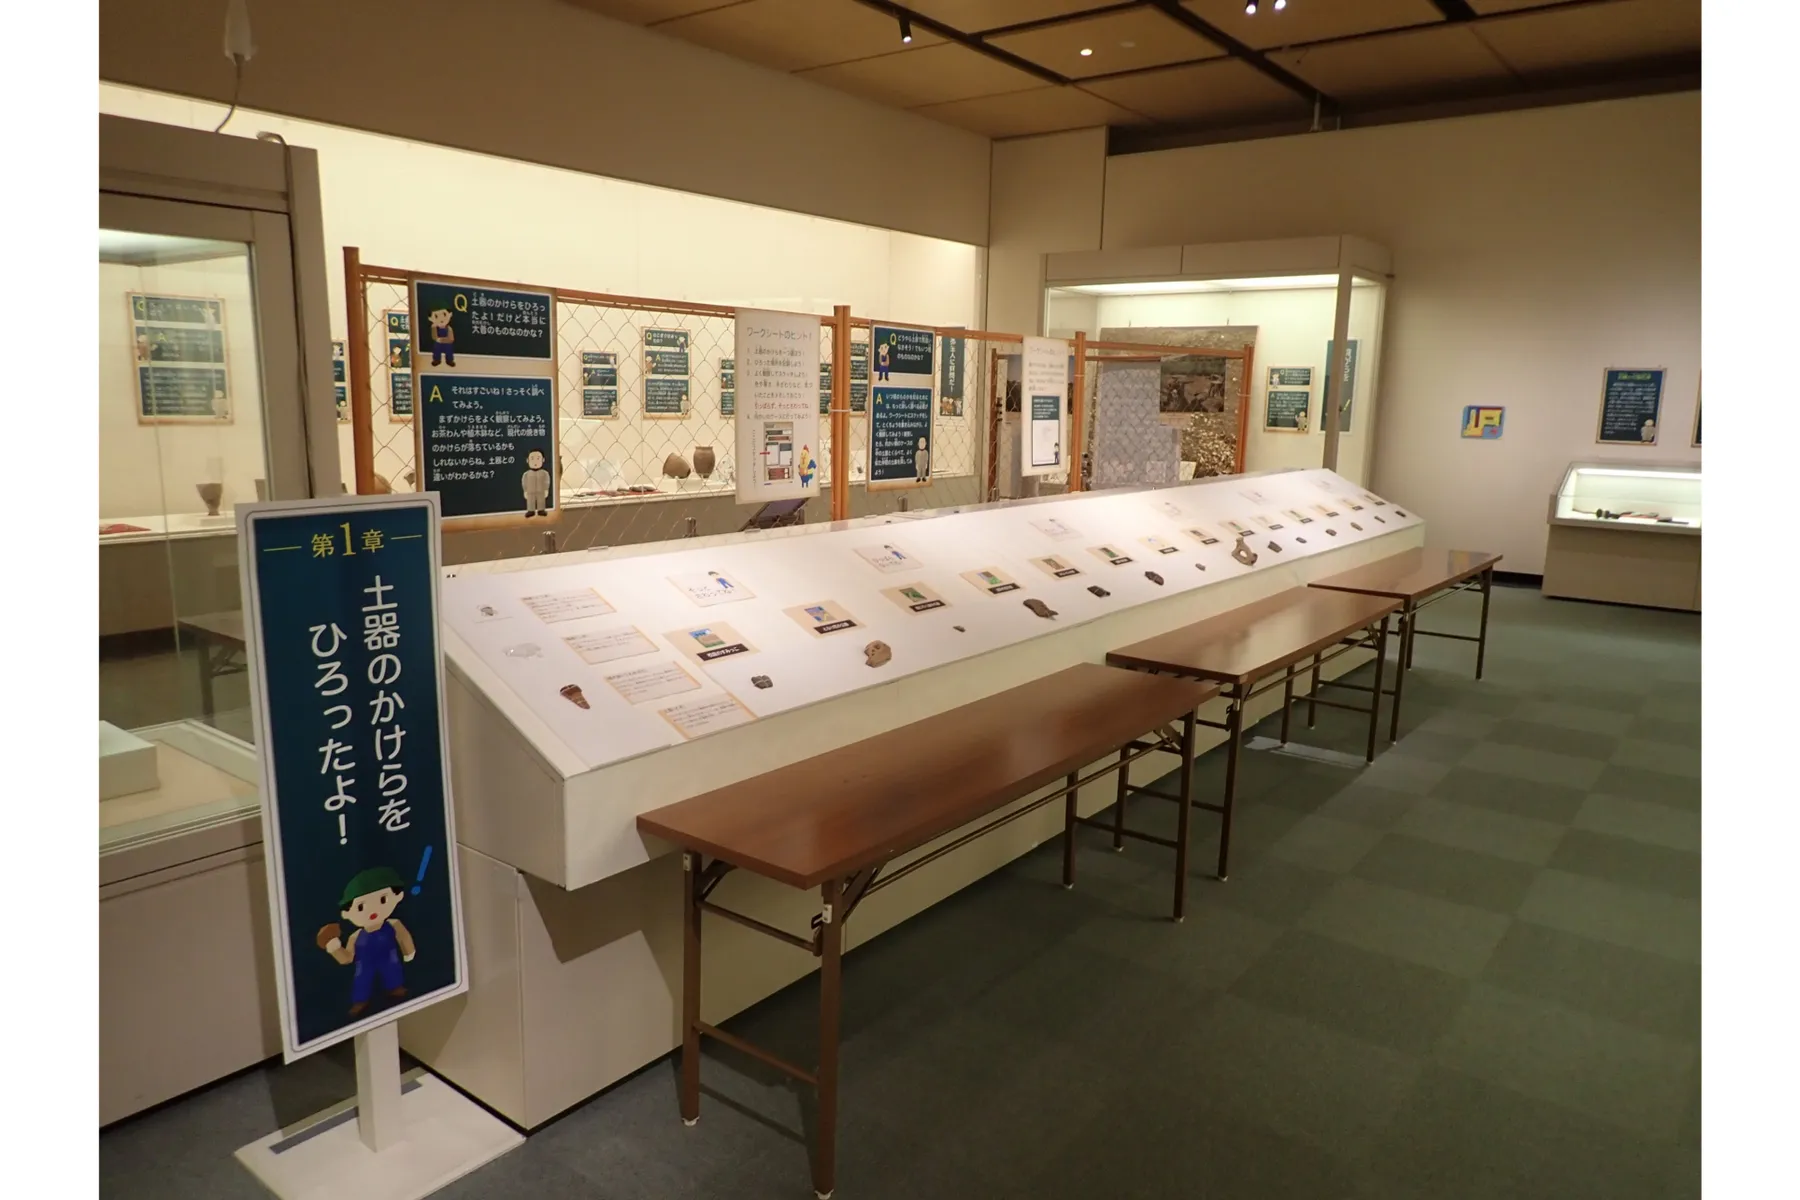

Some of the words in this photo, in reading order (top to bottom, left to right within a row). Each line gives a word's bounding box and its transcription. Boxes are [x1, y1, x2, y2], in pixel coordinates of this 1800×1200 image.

[454, 293, 468, 312] Q
[889, 333, 897, 345] Q
[429, 384, 444, 402] A
[875, 393, 883, 405] A
[311, 521, 385, 558] 第1章
[361, 574, 411, 832] 土器のかけらを
[308, 622, 358, 845] ひろったよ!
